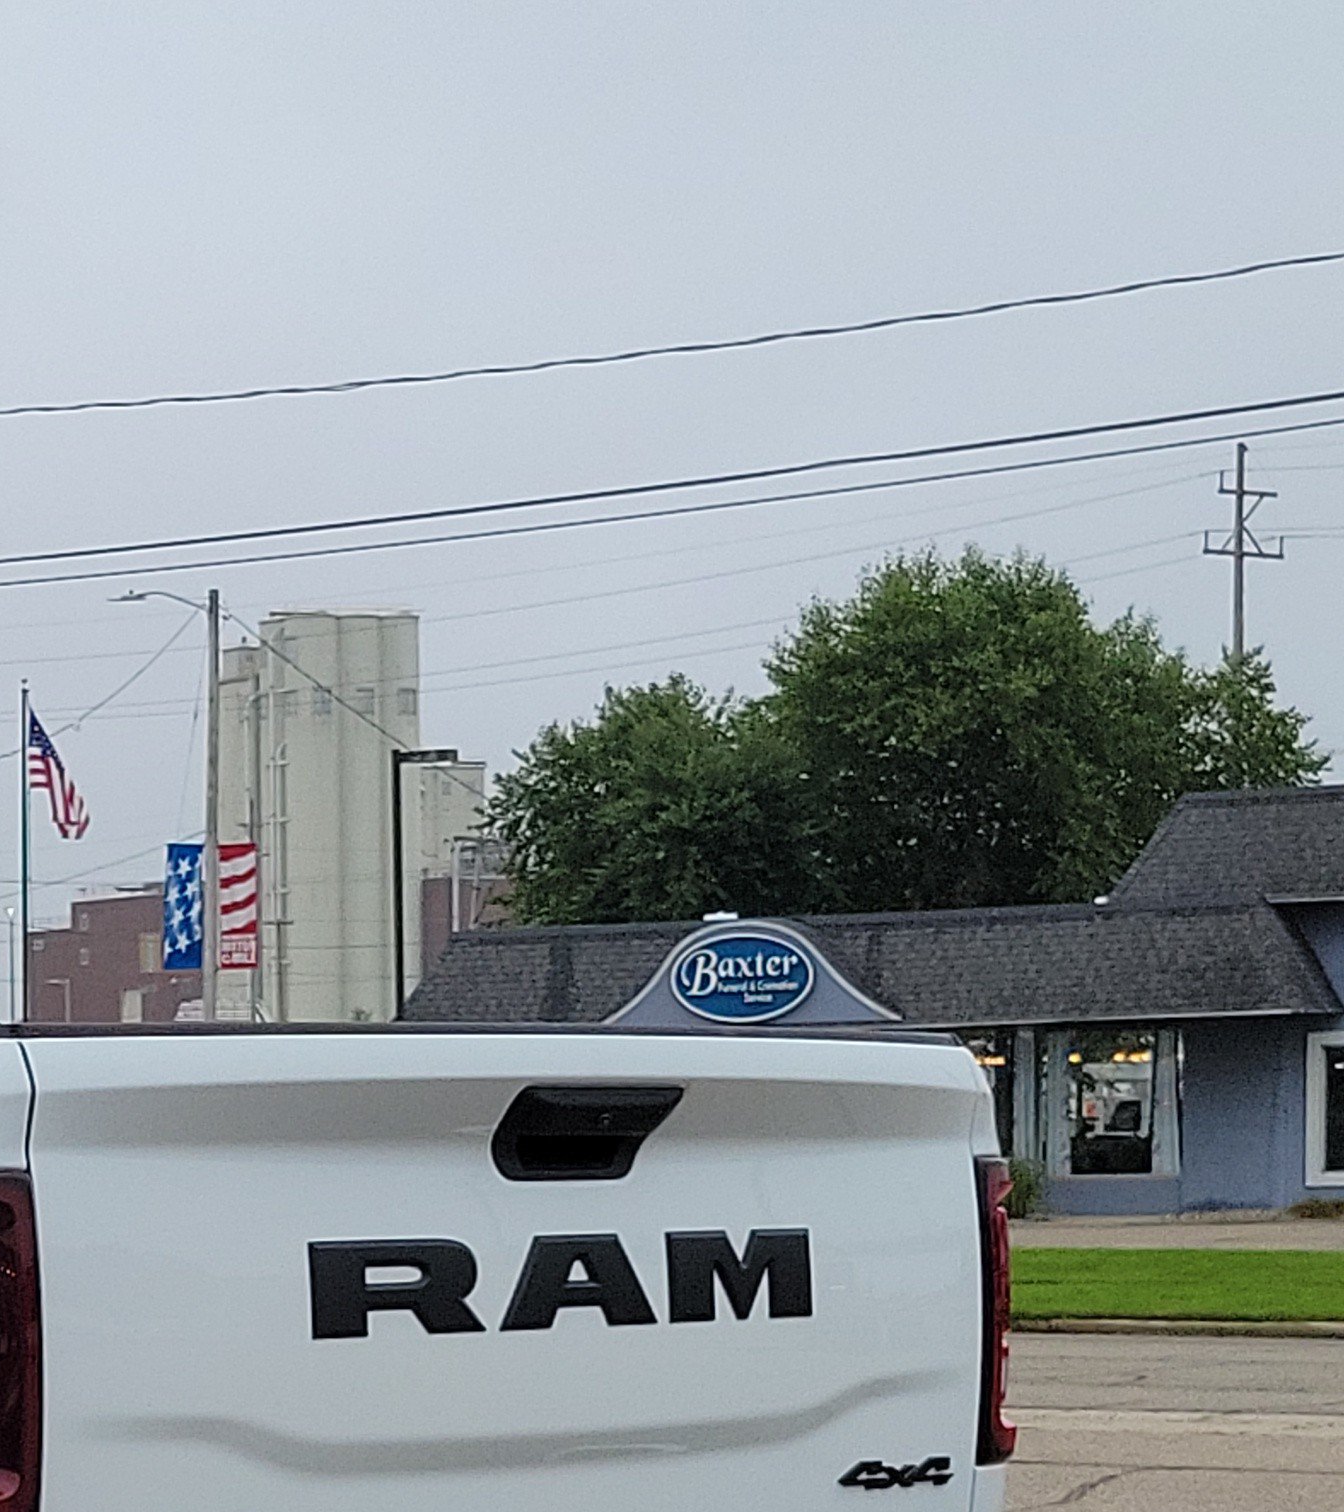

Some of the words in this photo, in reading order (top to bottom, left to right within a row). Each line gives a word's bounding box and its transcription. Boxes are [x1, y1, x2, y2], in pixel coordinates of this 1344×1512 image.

[680, 948, 799, 996] Baxter
[308, 1227, 814, 1340] RAM
[837, 1456, 954, 1490] 4x4
